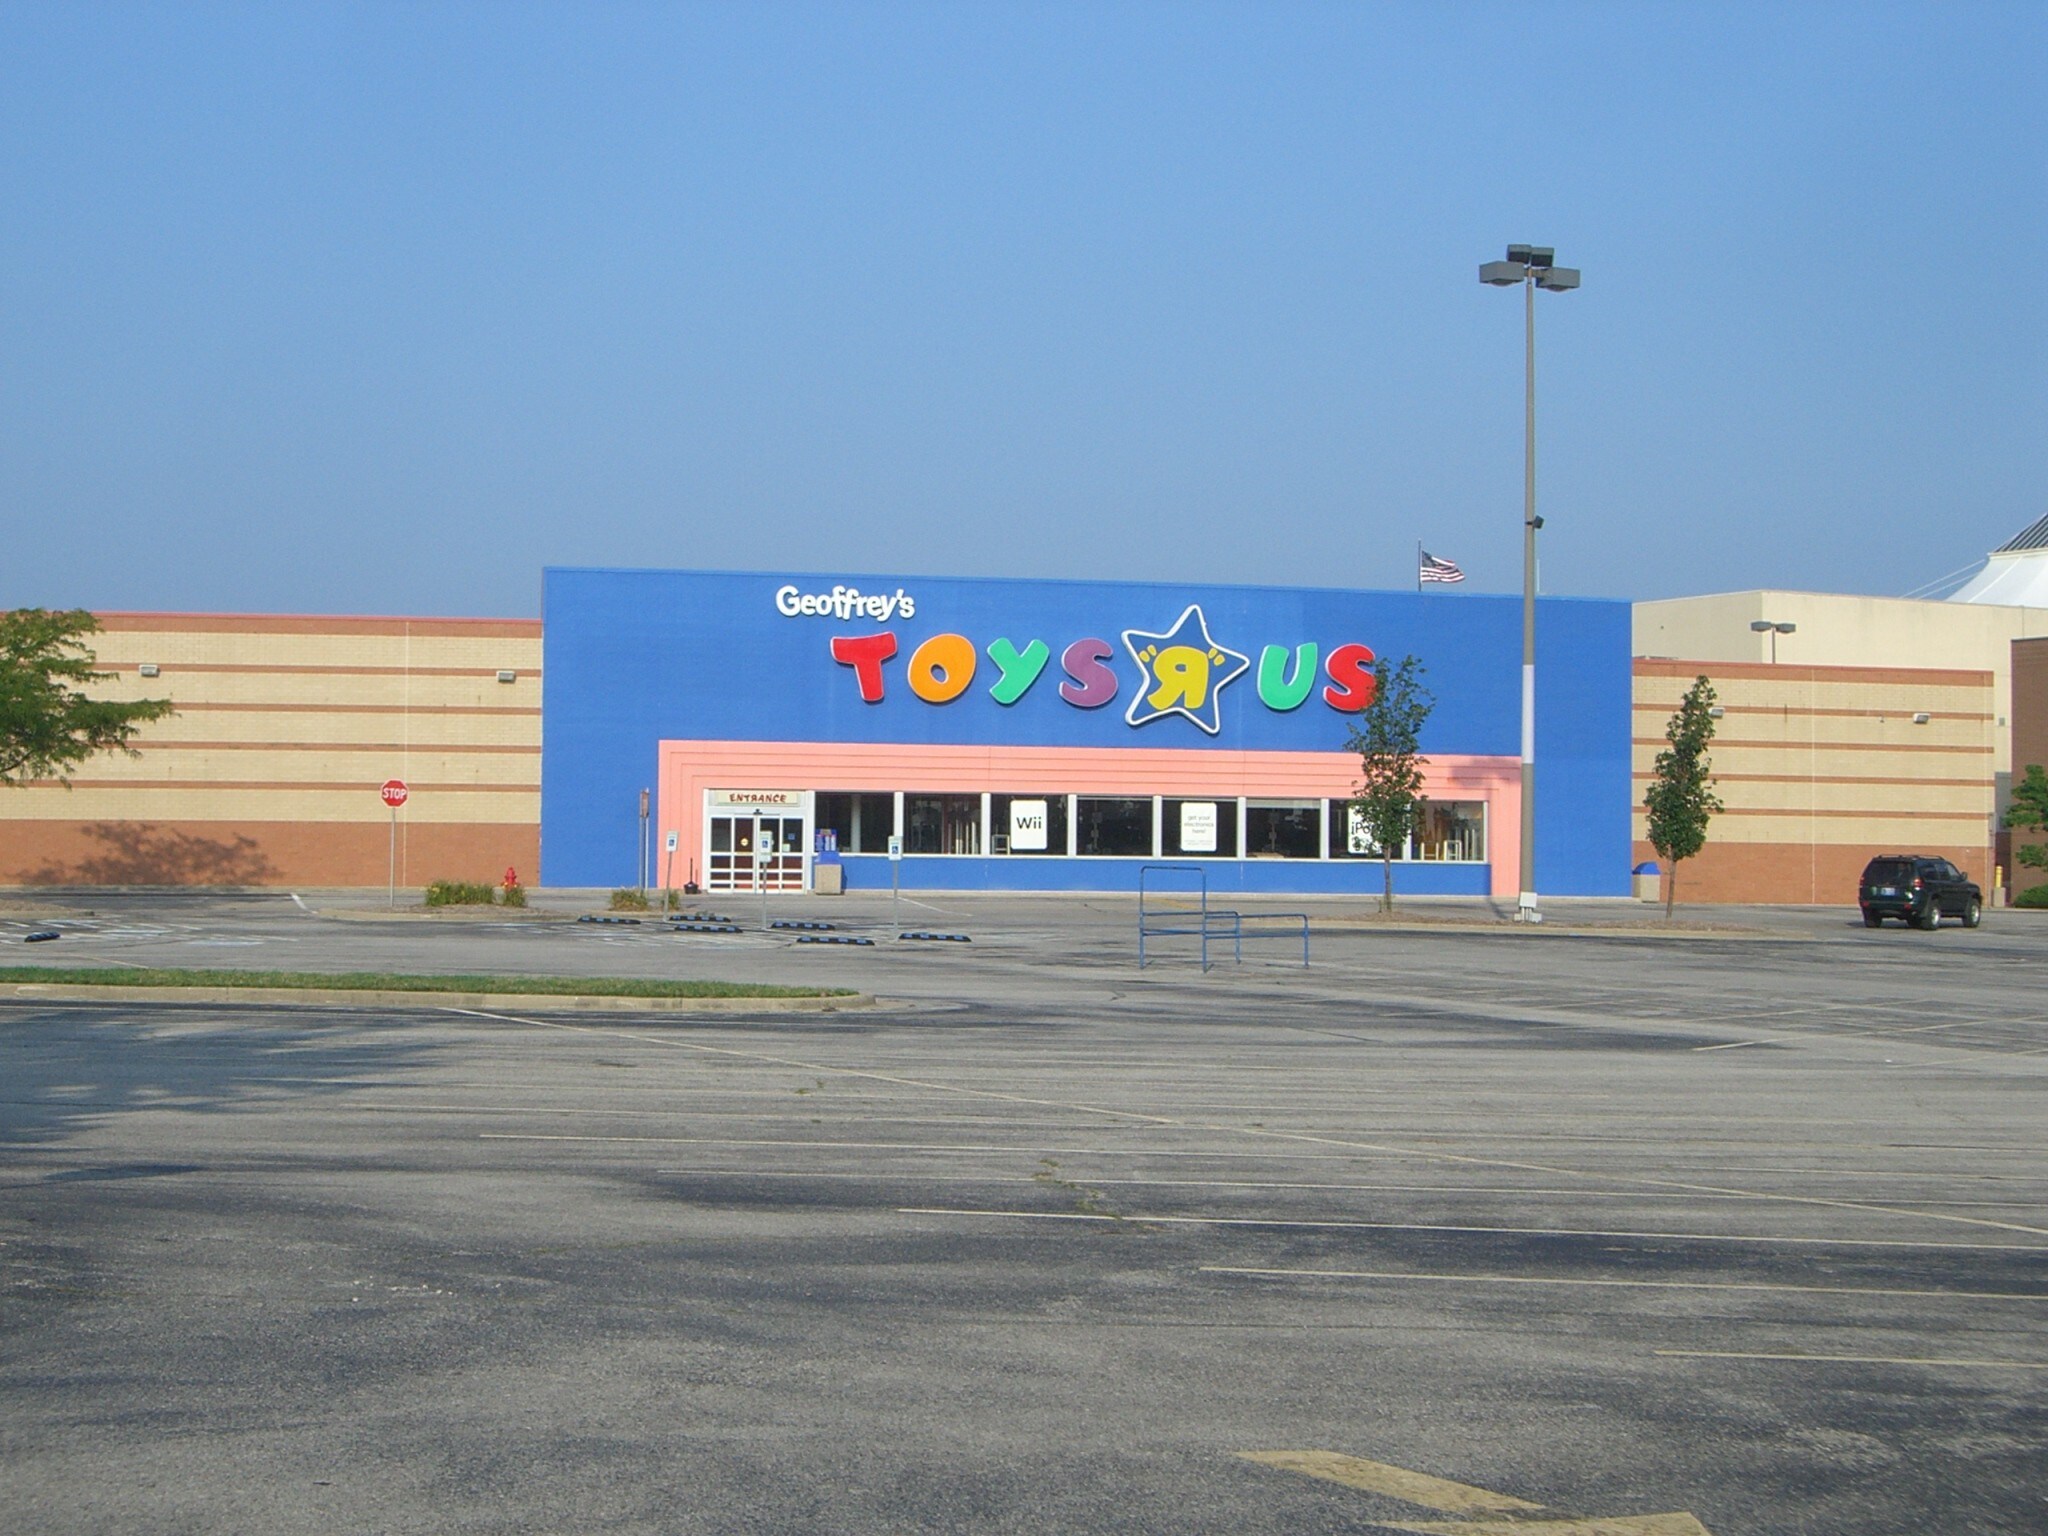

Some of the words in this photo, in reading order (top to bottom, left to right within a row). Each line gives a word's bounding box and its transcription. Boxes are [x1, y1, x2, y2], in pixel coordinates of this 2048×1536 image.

[776, 585, 915, 622] Geoffrey's
[830, 631, 1118, 707] TOYS
[1257, 642, 1377, 711] US
[382, 787, 407, 799] STOP
[729, 793, 787, 803] ENTRANCE
[1016, 816, 1042, 829] Wii
[1351, 821, 1377, 835] iPo
